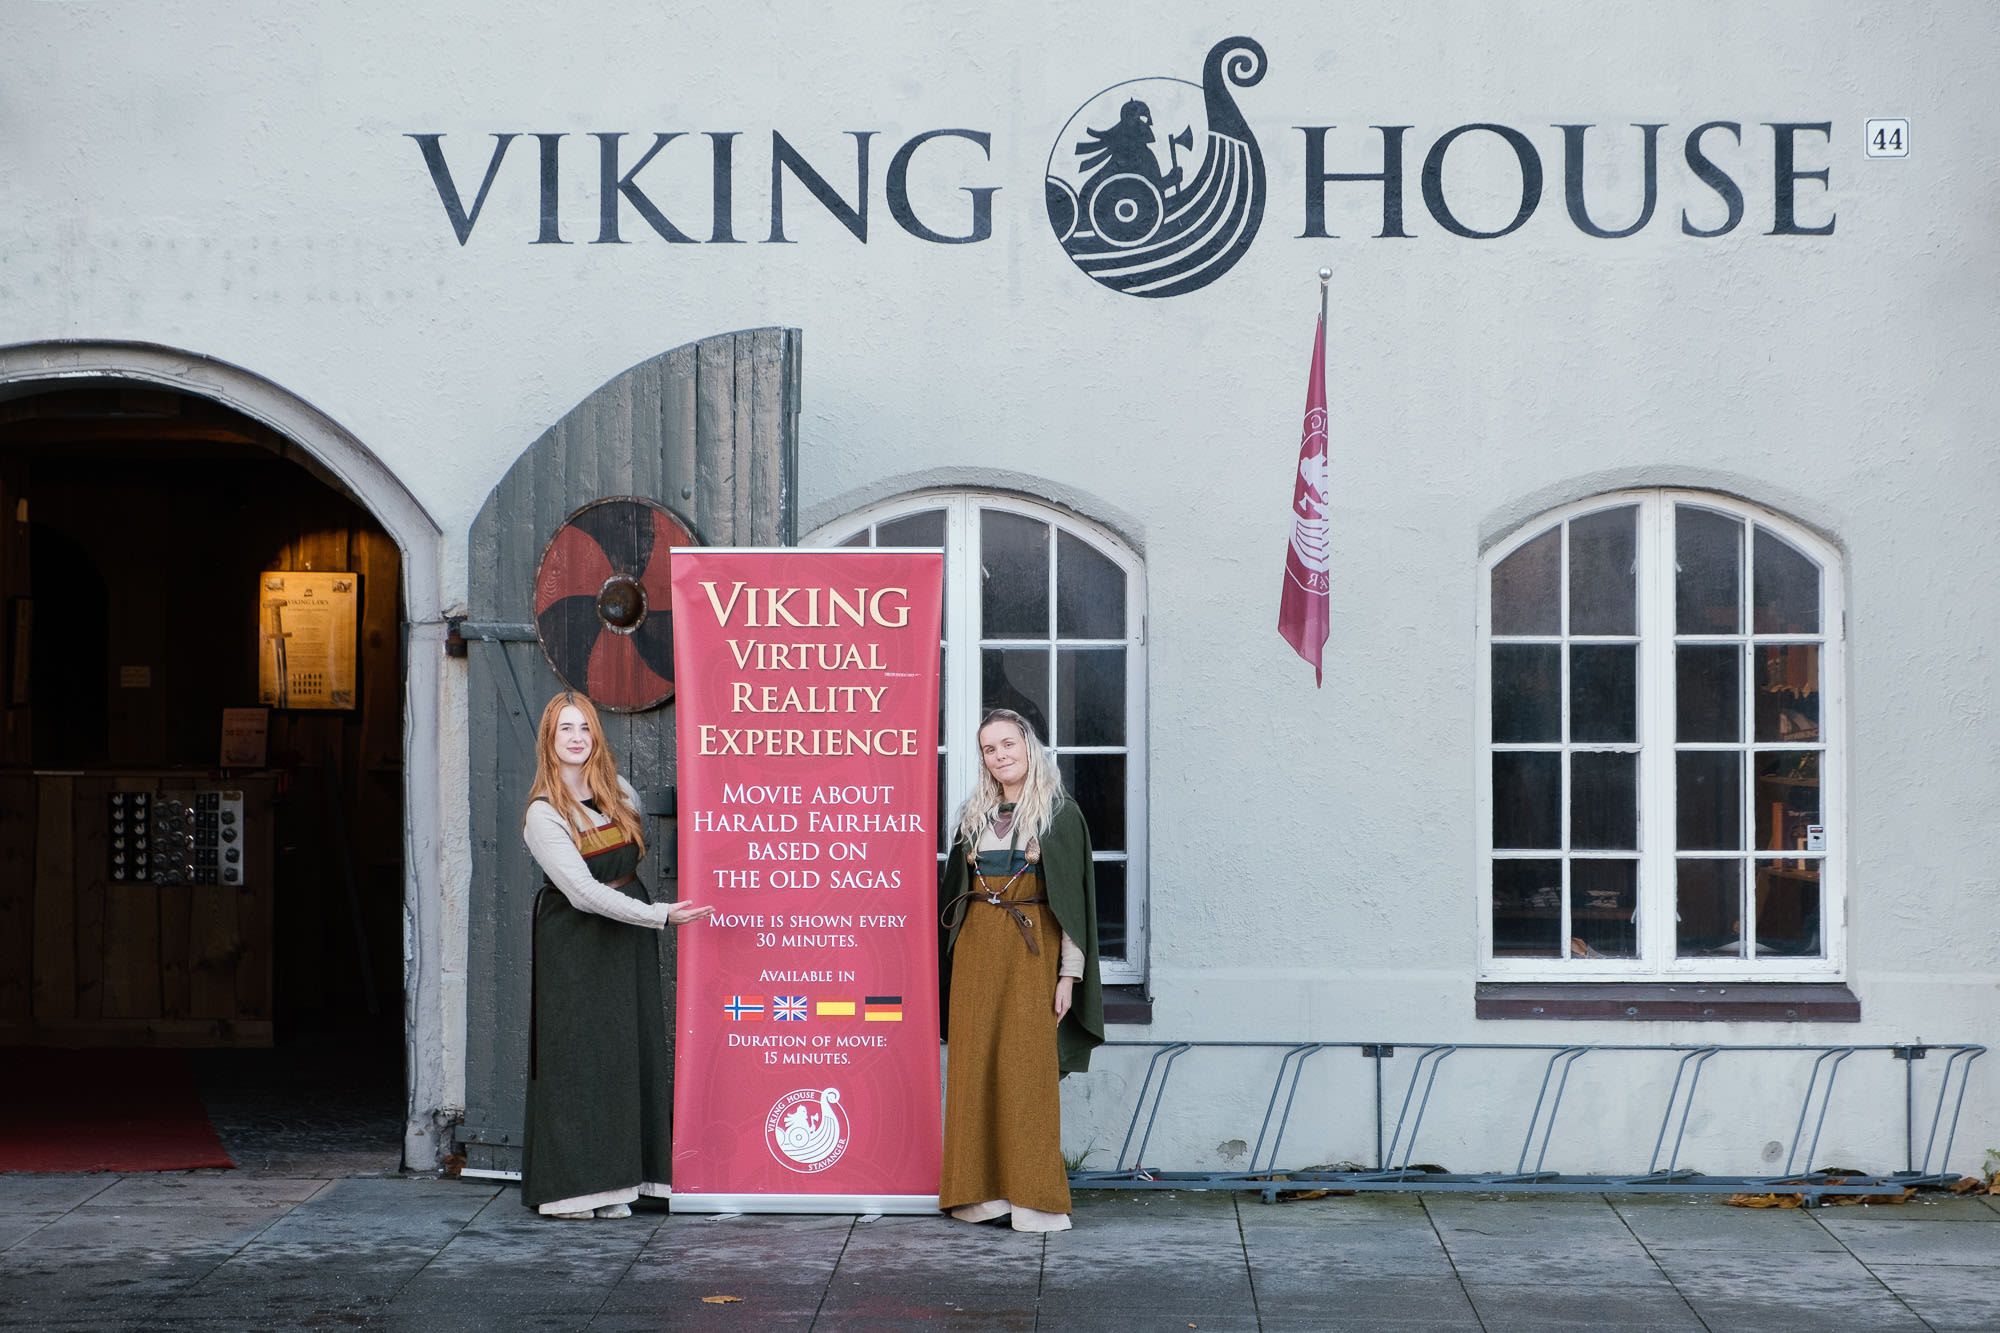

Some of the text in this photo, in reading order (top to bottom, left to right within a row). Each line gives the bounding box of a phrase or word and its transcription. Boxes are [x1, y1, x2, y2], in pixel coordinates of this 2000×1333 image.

[1874, 128, 1902, 149] 44
[403, 121, 1836, 246] VIKING HOUSE
[699, 582, 911, 627] VIKING
[726, 640, 886, 669] VIRTUAL
[731, 683, 888, 712] REALITY
[698, 725, 917, 755] EXPERIENCE
[722, 784, 894, 804] MOVIE ABOUT
[694, 811, 925, 832] HARALD FAIRHAIR
[748, 842, 867, 860] BASED ON
[713, 870, 900, 888] THE OLD SAGAS
[710, 913, 906, 927] MOVIE IS SHOWN EVERY
[757, 933, 857, 947] 30 MINUTES.
[759, 970, 854, 981] AVAILABLE IN
[729, 1034, 887, 1047] DURATION OF MOVIE:
[765, 1052, 850, 1064] 15 MINUTES.
[767, 1091, 815, 1132] VIKING HOUSE
[807, 1138, 846, 1171] STAVANGER
